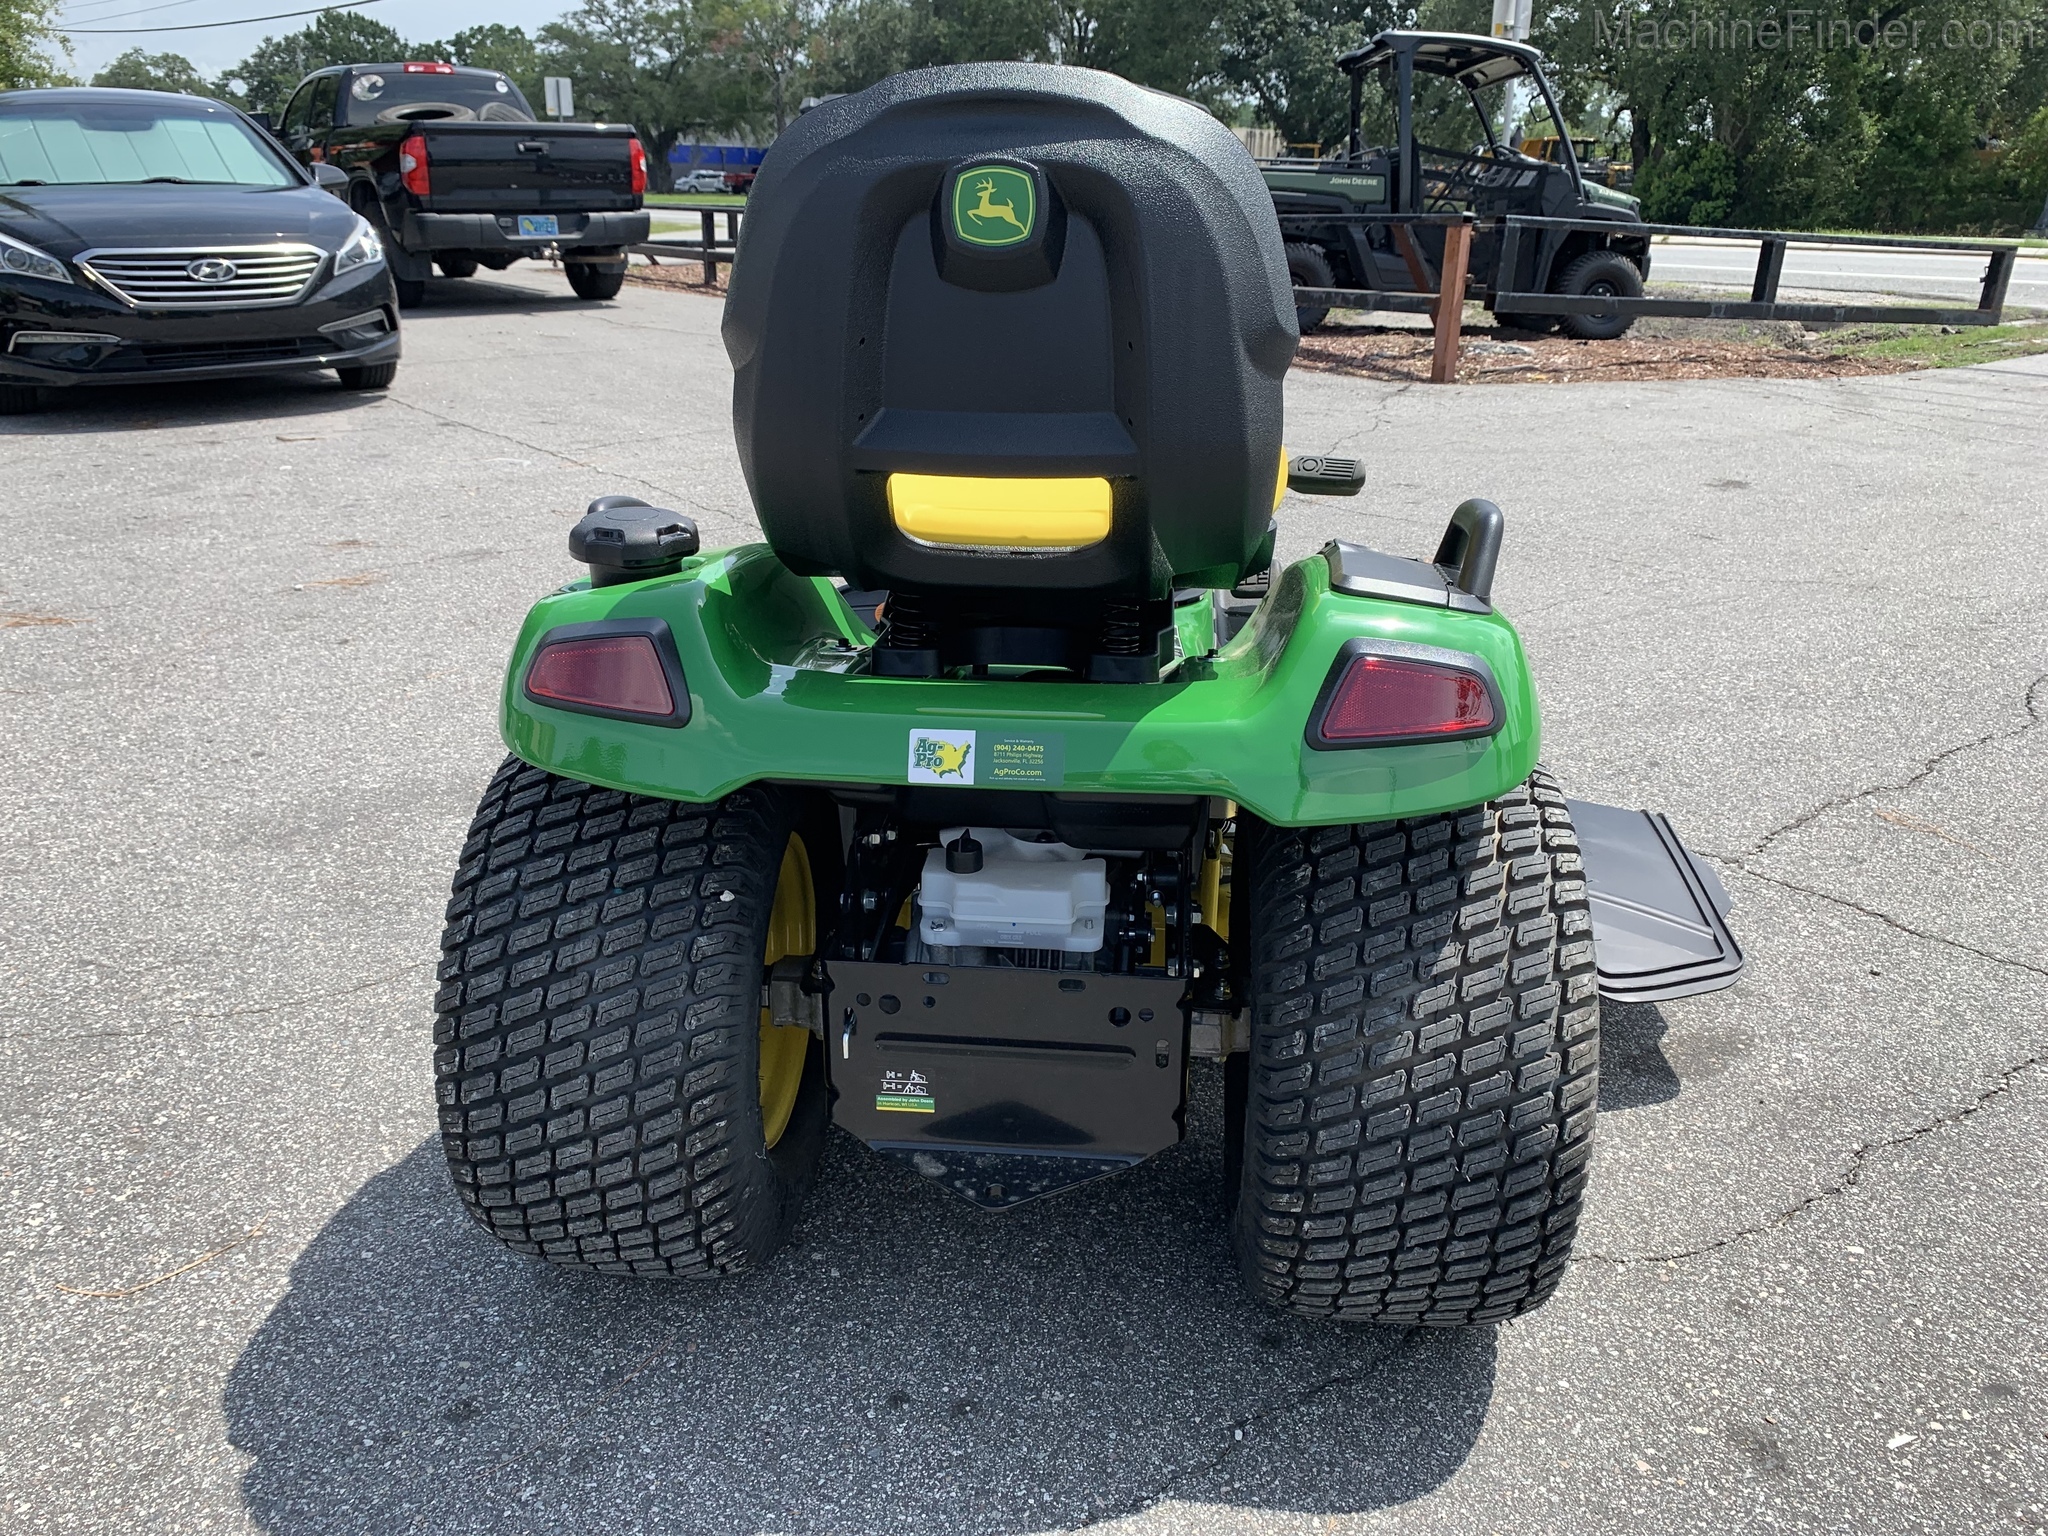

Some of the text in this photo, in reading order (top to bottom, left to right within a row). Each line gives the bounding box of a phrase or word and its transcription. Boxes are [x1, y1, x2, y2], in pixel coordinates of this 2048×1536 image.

[1330, 176, 1378, 186] JOHN DEERE
[914, 737, 945, 757] Ag-
[993, 744, 1044, 752] (904) 240-0475
[913, 753, 944, 769] Pro
[993, 768, 1042, 777] AgProCo.com
